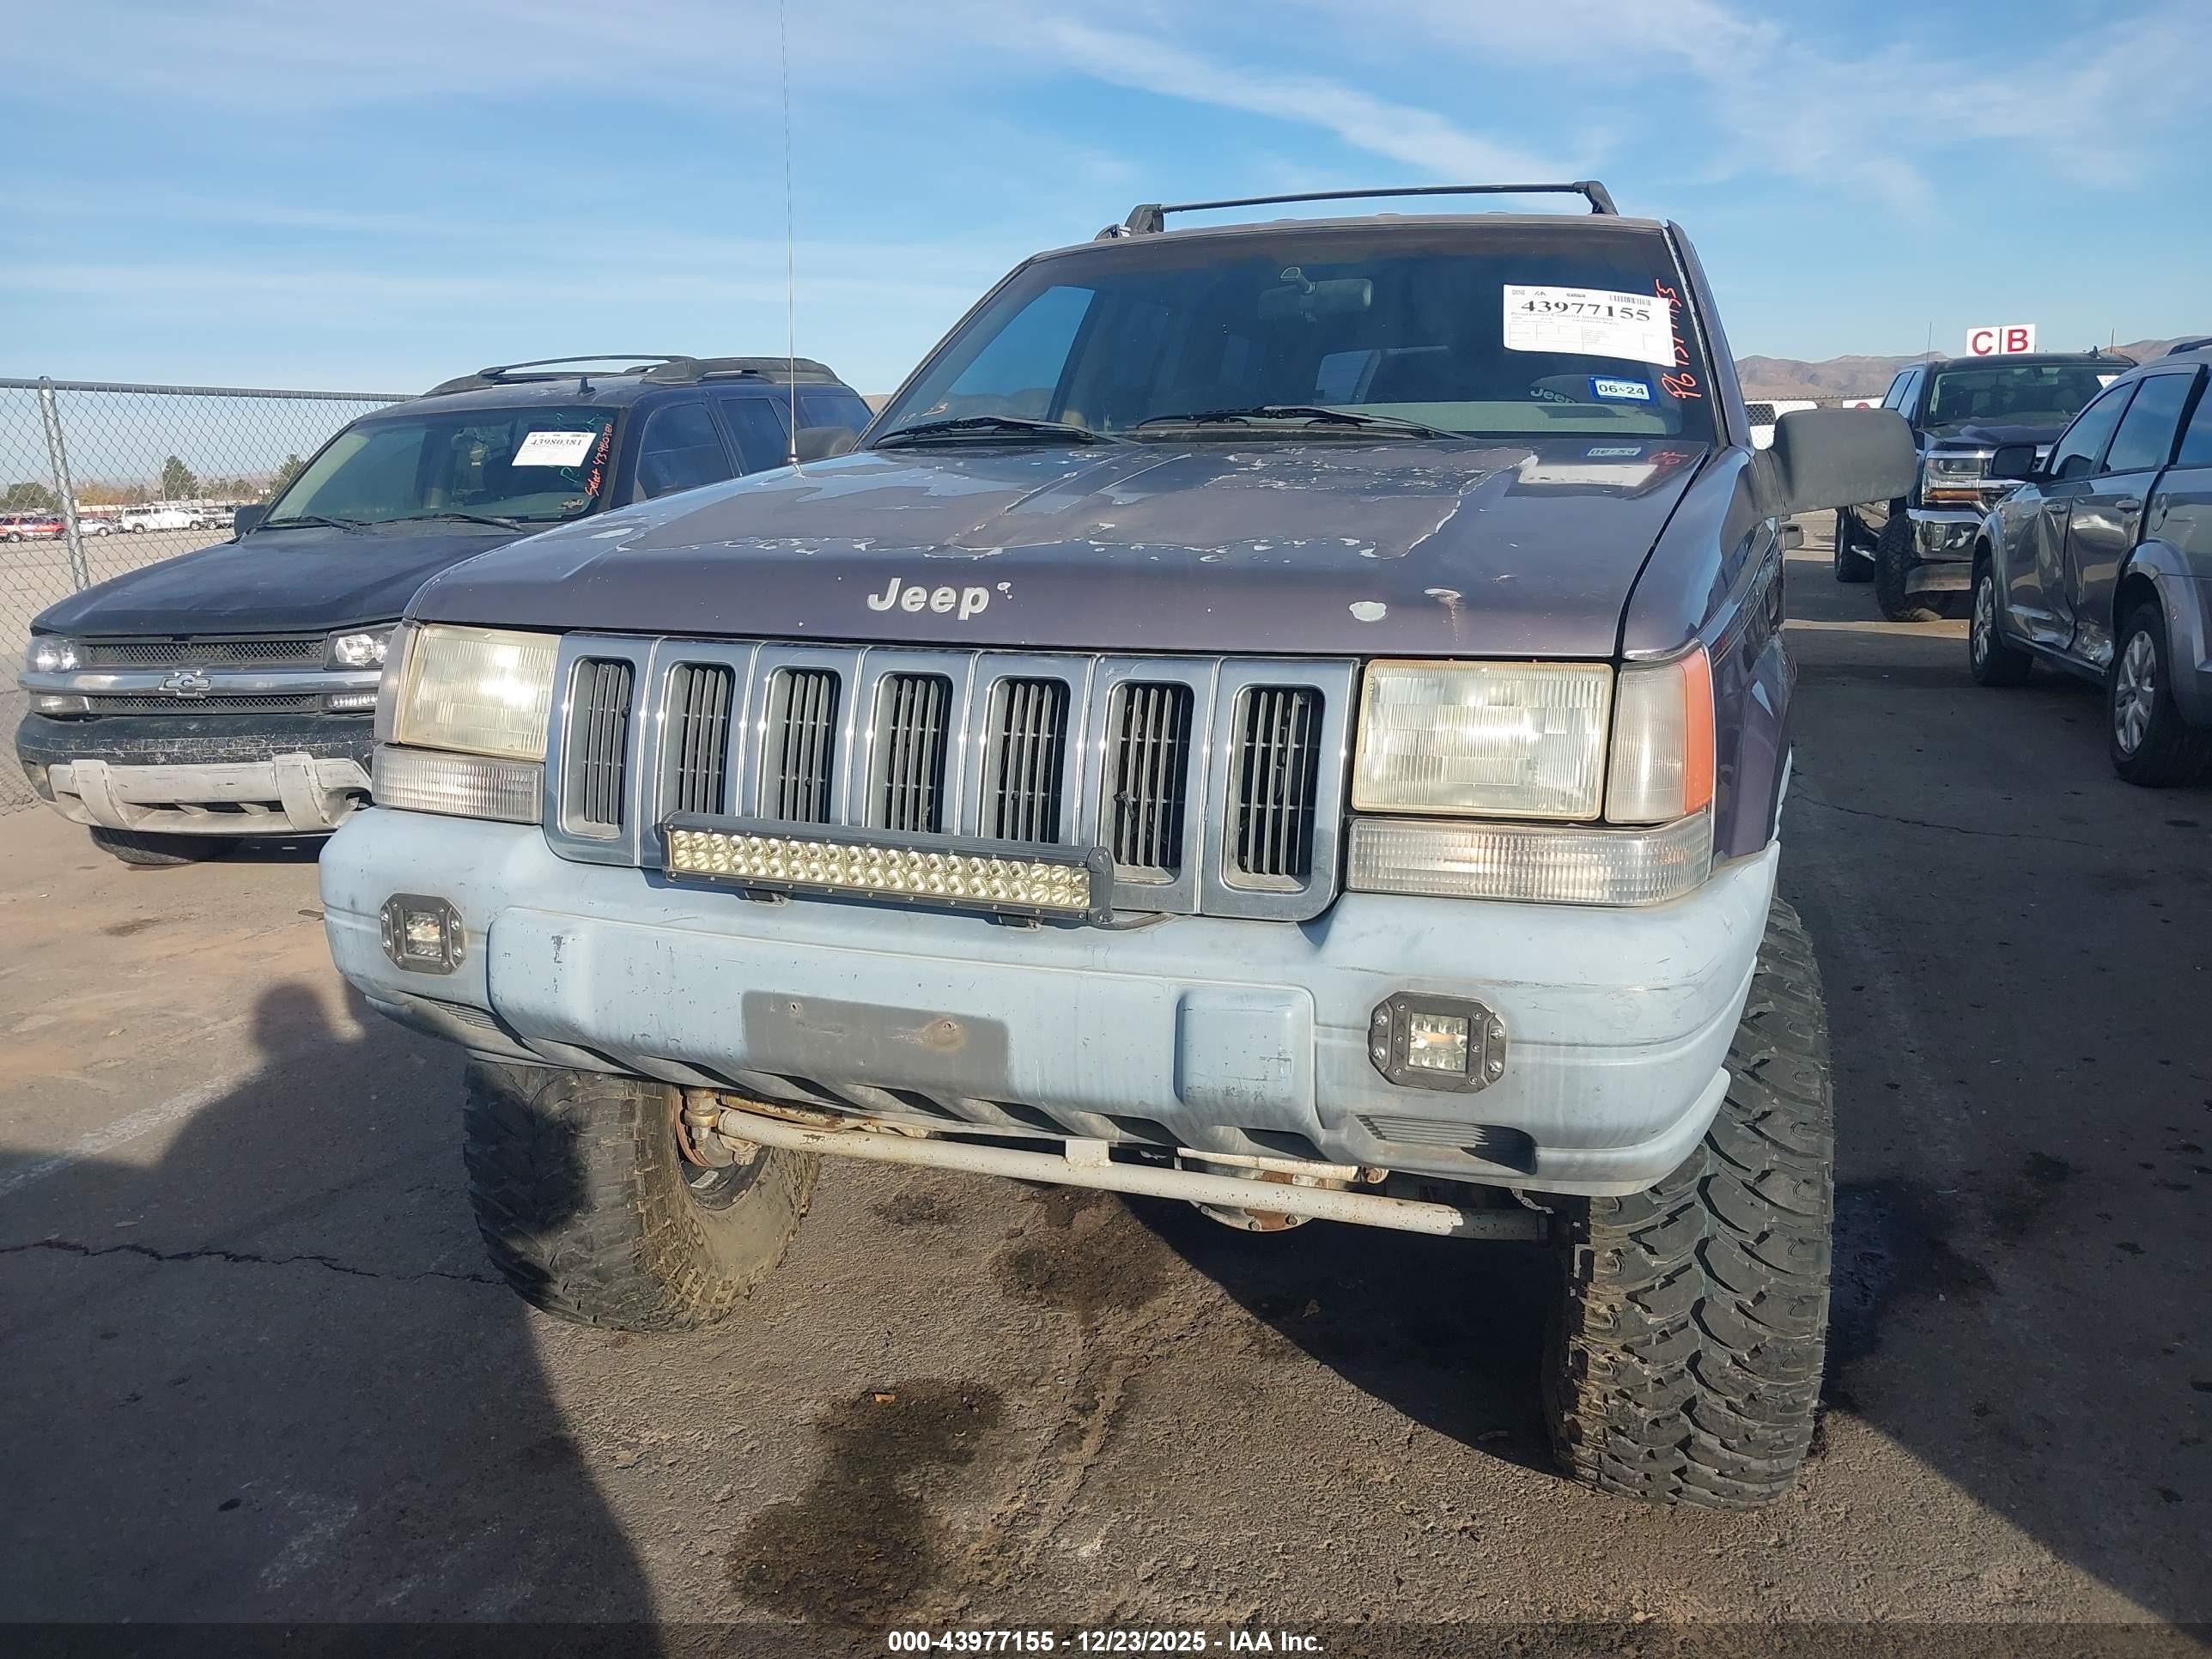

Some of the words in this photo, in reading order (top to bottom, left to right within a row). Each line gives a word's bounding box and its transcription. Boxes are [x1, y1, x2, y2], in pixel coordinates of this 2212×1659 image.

[1521, 301, 1650, 321] 43977155
[1972, 331, 1993, 355] C
[2008, 329, 2028, 352] B
[867, 577, 989, 621] Jeep
